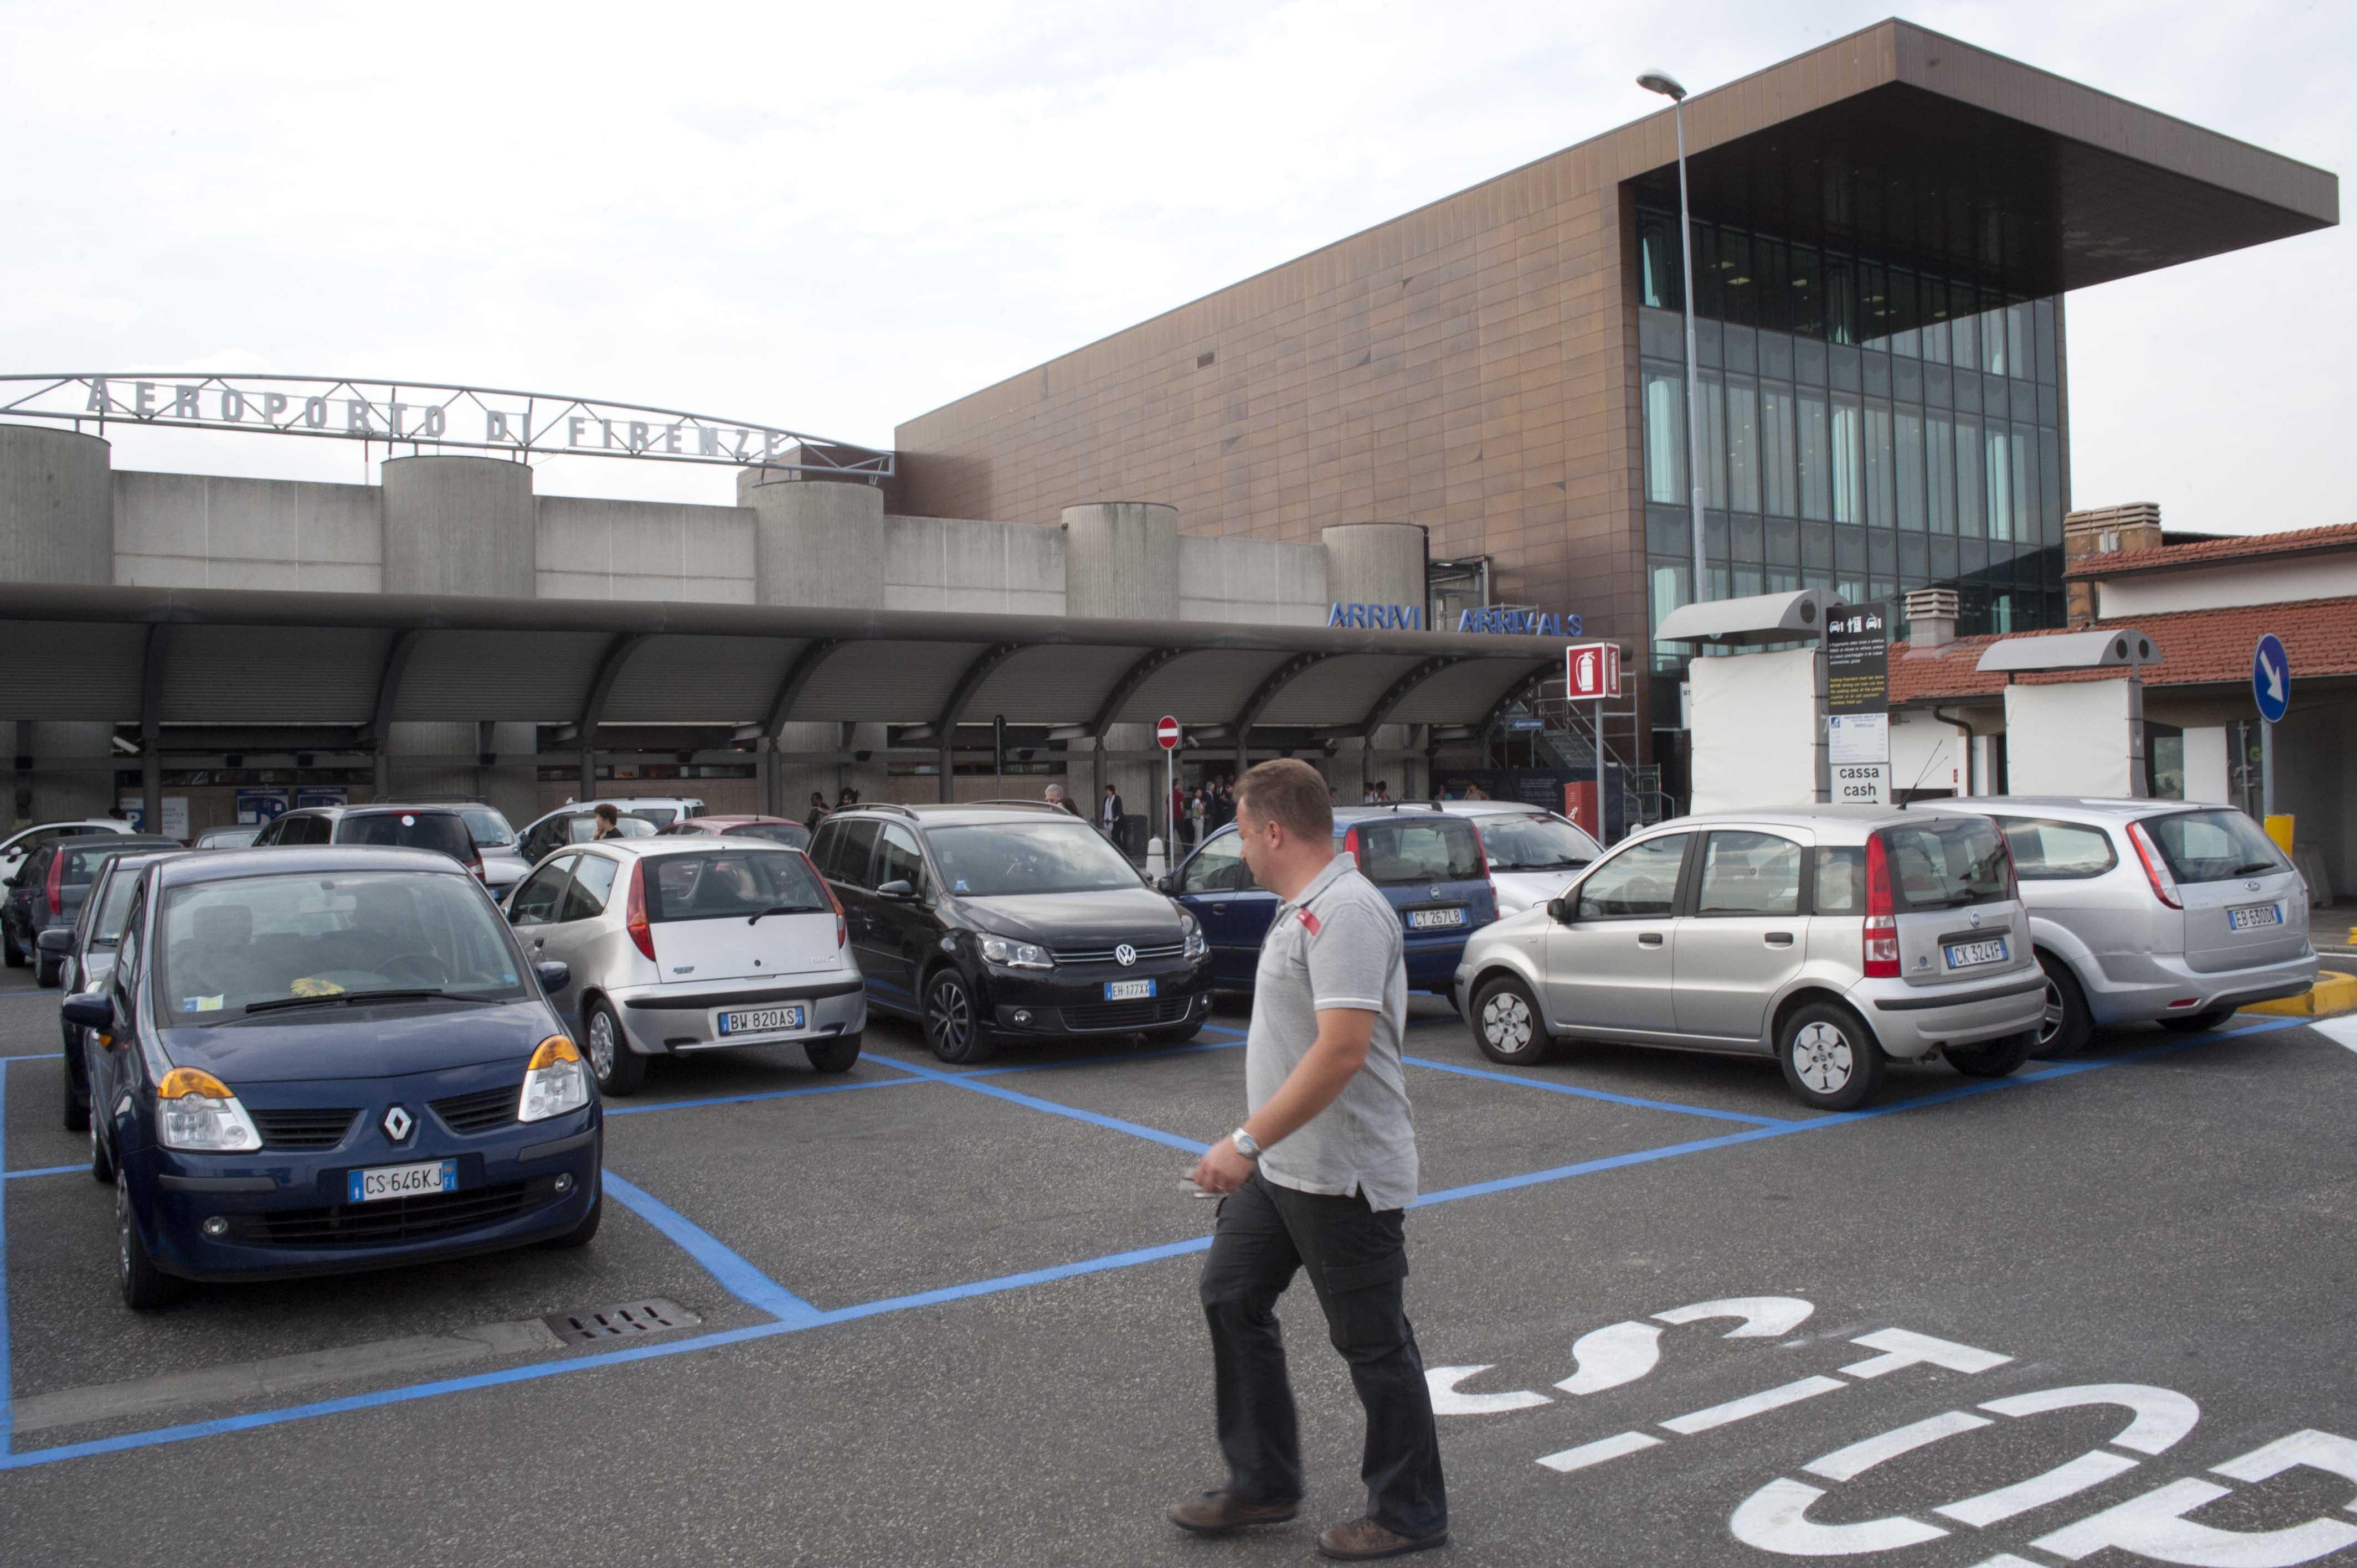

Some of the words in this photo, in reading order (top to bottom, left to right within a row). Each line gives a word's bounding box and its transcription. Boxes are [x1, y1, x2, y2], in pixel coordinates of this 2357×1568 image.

[86, 378, 445, 437] AEROPORTO
[487, 410, 531, 445] DI
[568, 416, 780, 460] FIRENZE
[1327, 602, 1421, 630] ARRIVI
[1458, 608, 1583, 637] ARRIVALS
[1840, 767, 1879, 778] cassa
[1844, 782, 1876, 796] cash
[1414, 912, 1427, 926] CY
[1430, 910, 1461, 924] 267LB
[2235, 910, 2250, 927] EB
[2250, 906, 2278, 924] 630DK
[1954, 946, 1970, 964] CK
[1970, 942, 1999, 962] 324XF
[1113, 986, 1123, 997] EH
[1126, 983, 1149, 996] 177XX
[730, 1014, 748, 1030] BW
[753, 1010, 795, 1028] 820AS
[366, 1174, 386, 1194] CS
[390, 1167, 442, 1192] 646KJ
[444, 1175, 455, 1188] FI
[1423, 1296, 2357, 1568] STOP
